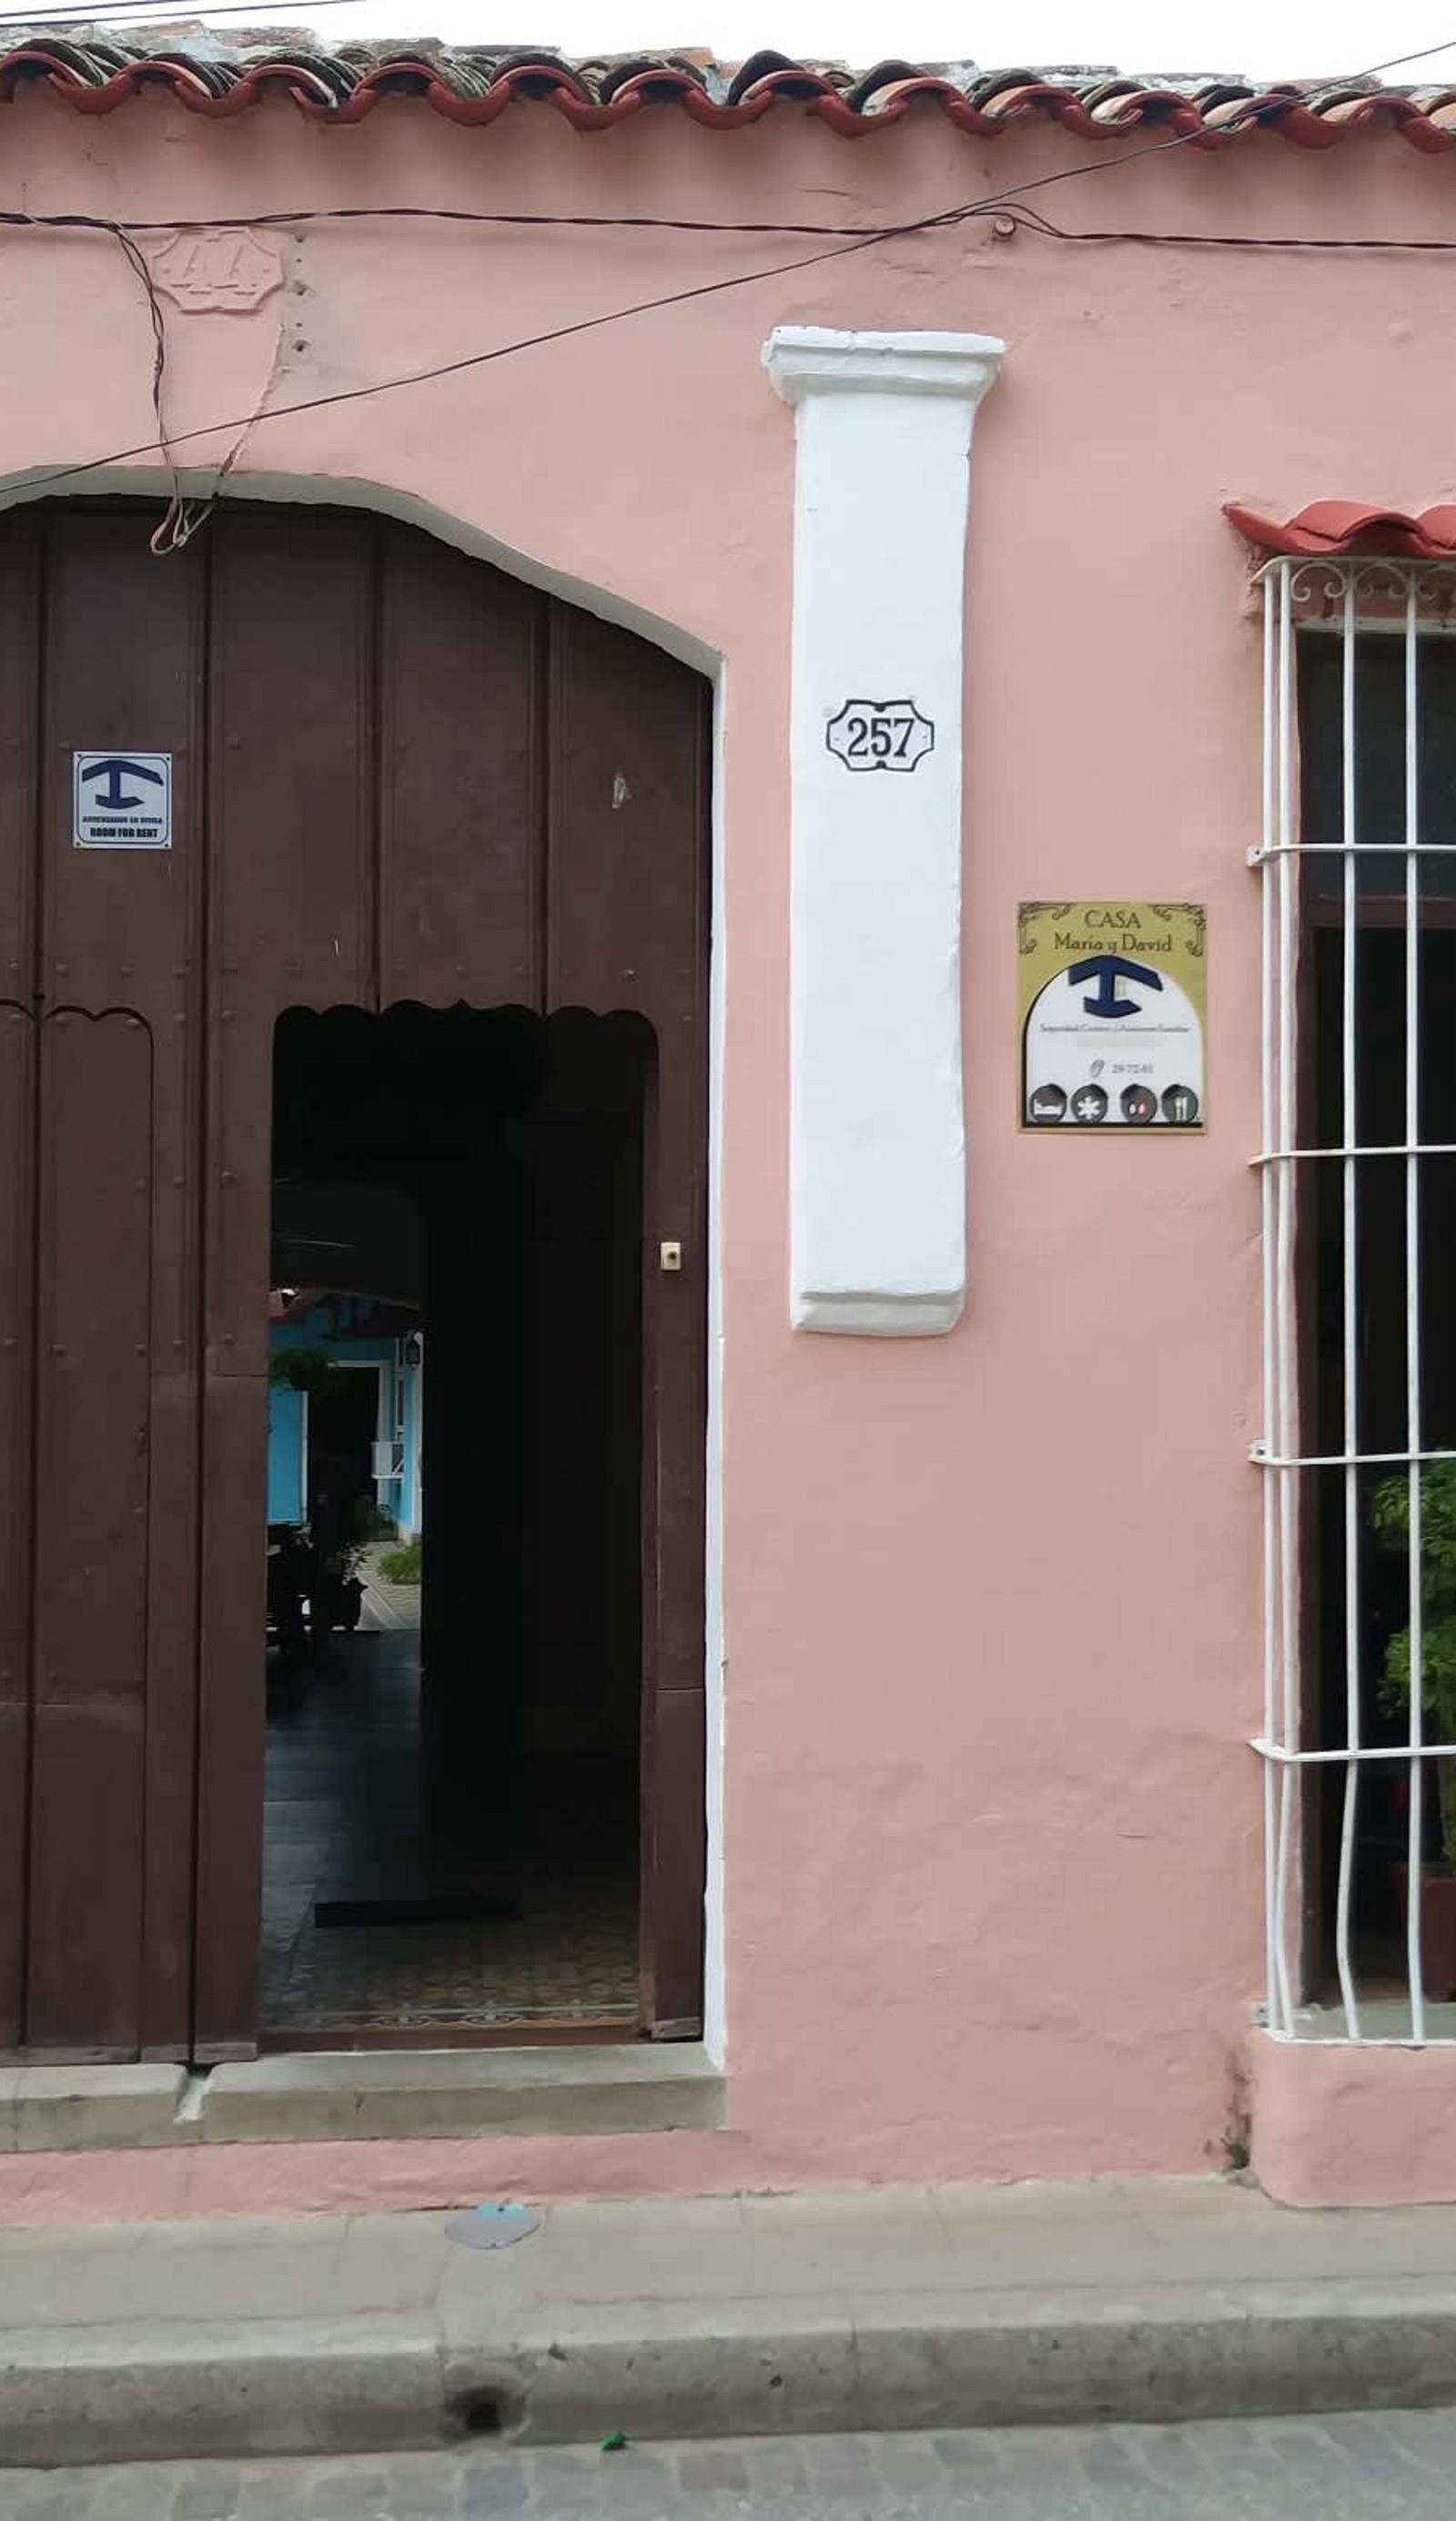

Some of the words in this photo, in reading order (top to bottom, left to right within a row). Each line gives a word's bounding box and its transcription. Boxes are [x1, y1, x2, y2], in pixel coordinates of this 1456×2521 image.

[847, 717, 915, 757] 257
[90, 827, 116, 837] ROOM
[117, 828, 135, 837] FOR
[136, 828, 158, 838] RENT
[1084, 910, 1142, 928] CASA
[1105, 941, 1118, 955] y
[1121, 934, 1173, 952] David
